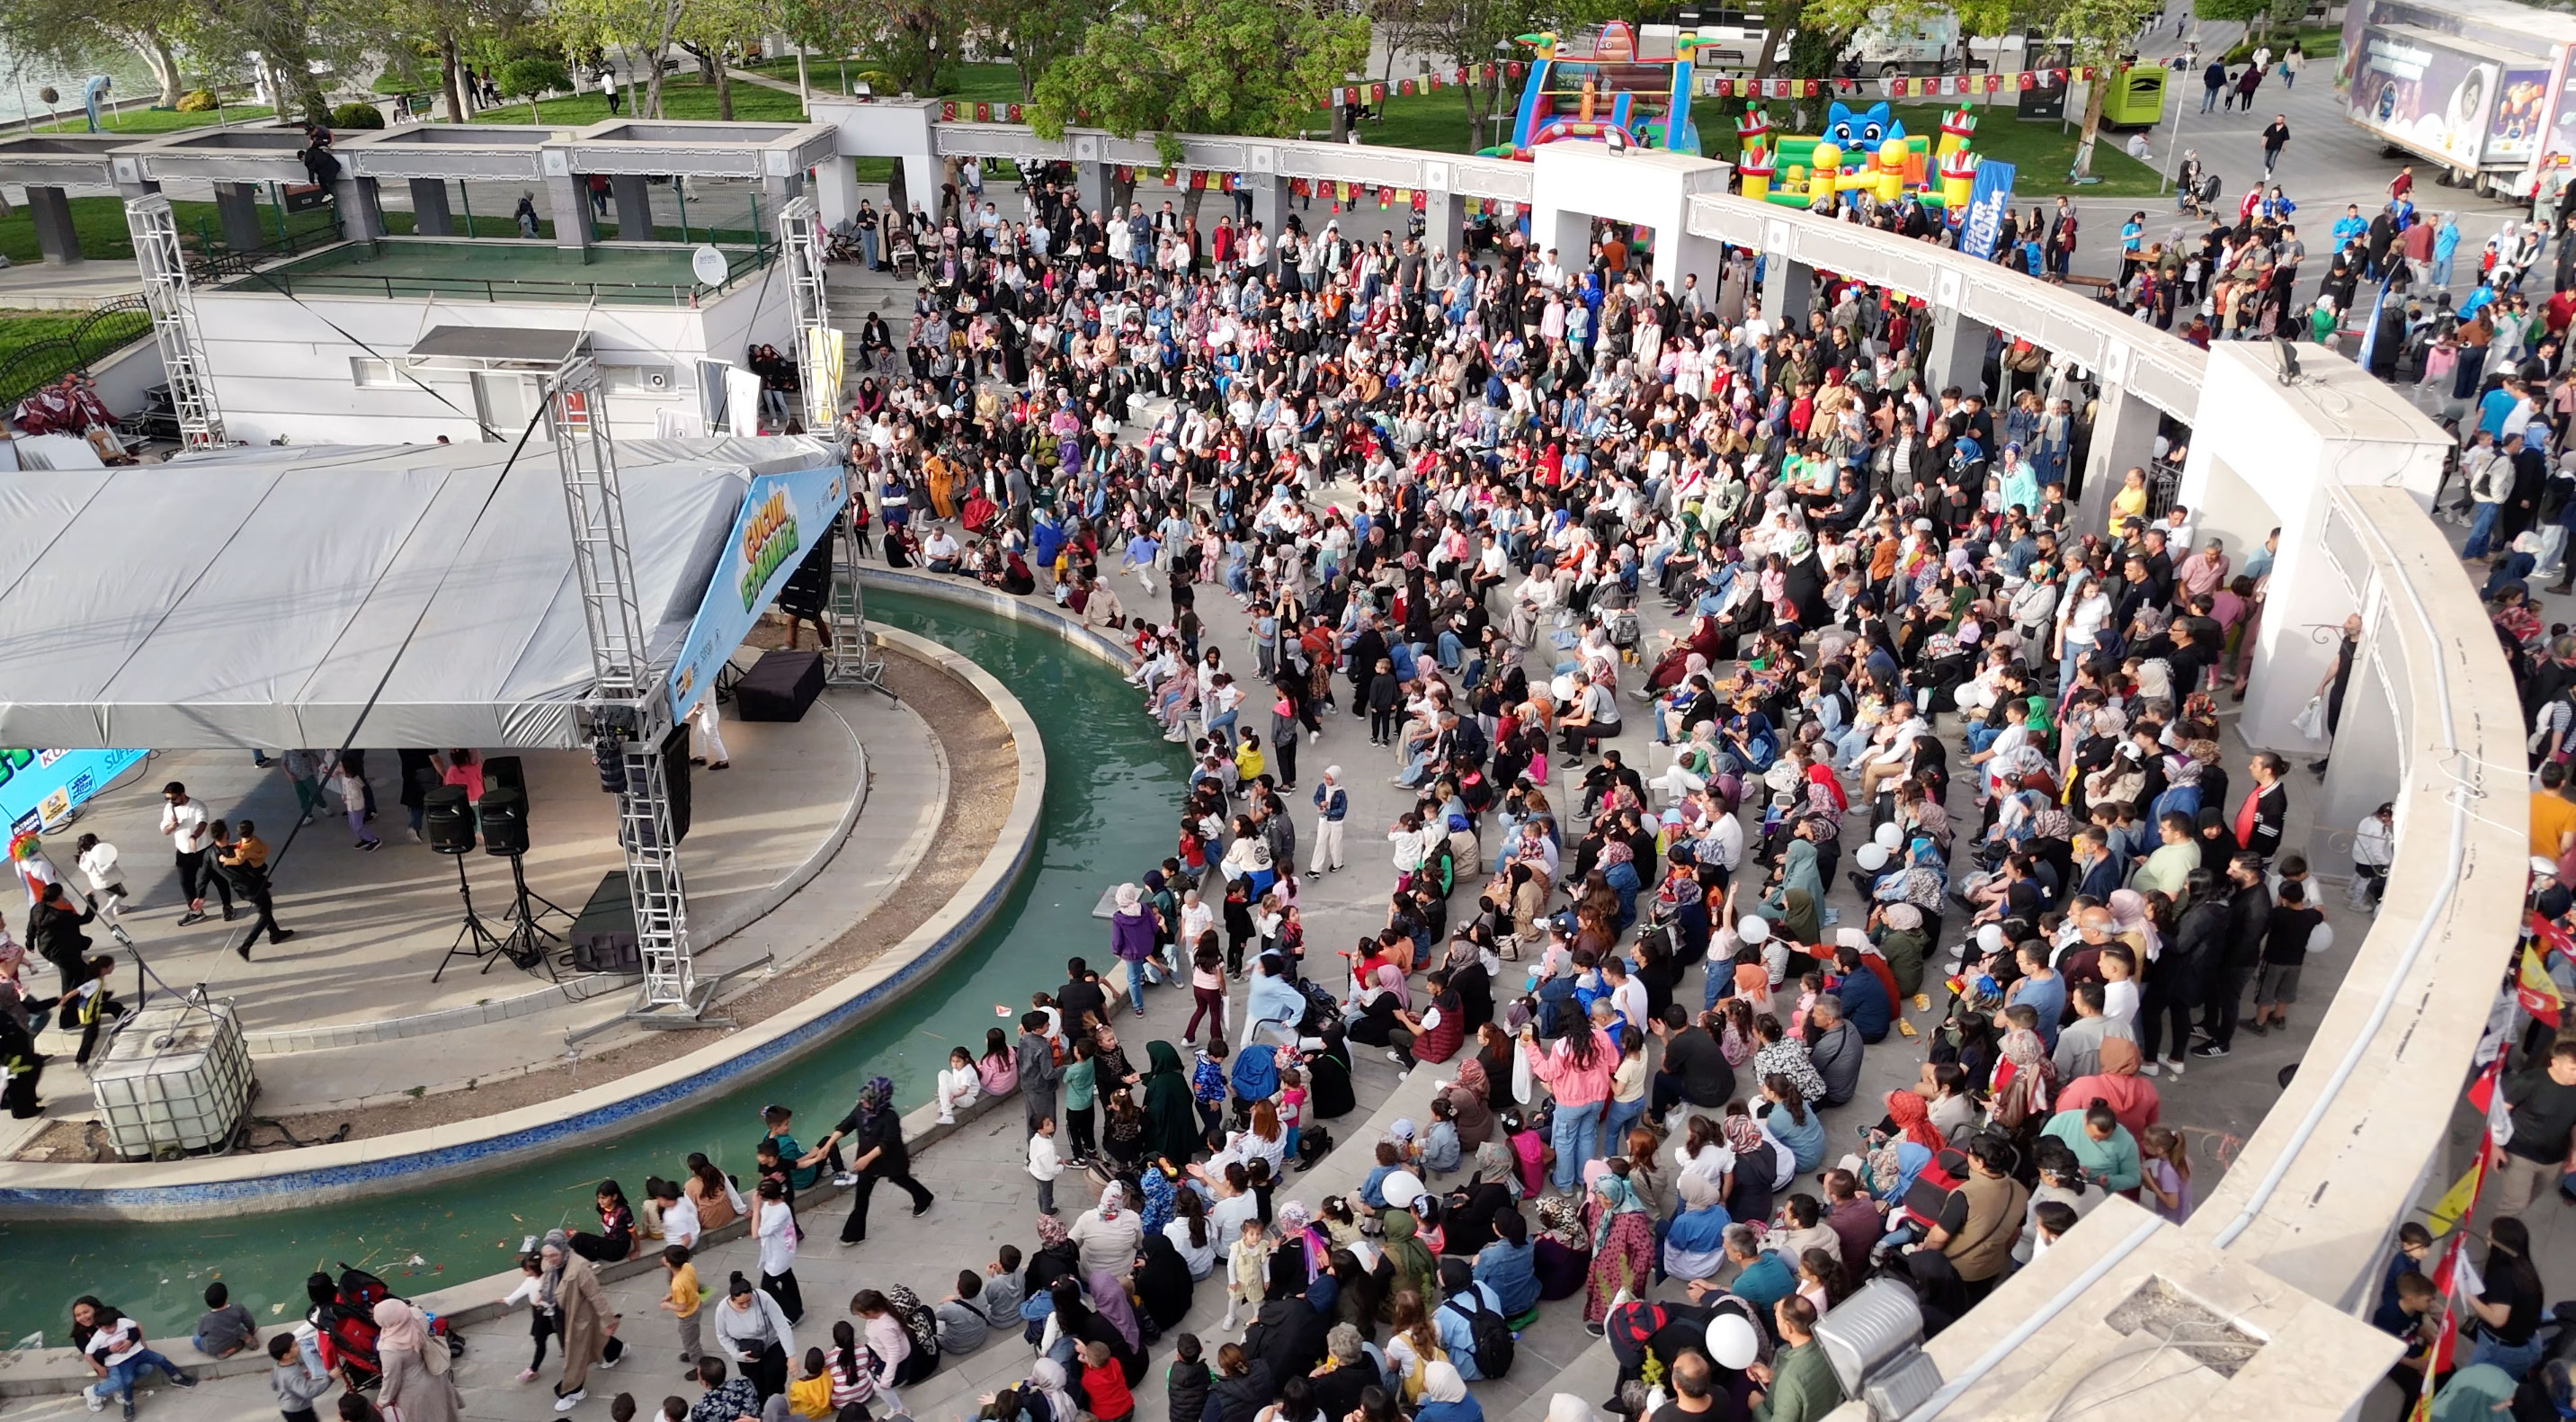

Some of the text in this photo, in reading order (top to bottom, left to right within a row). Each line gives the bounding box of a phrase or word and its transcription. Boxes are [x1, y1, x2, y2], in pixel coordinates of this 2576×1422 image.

[1964, 201, 1988, 254] SPOR
[1974, 190, 2006, 256] KONYA
[740, 513, 799, 615] ETKİNLİĞİ
